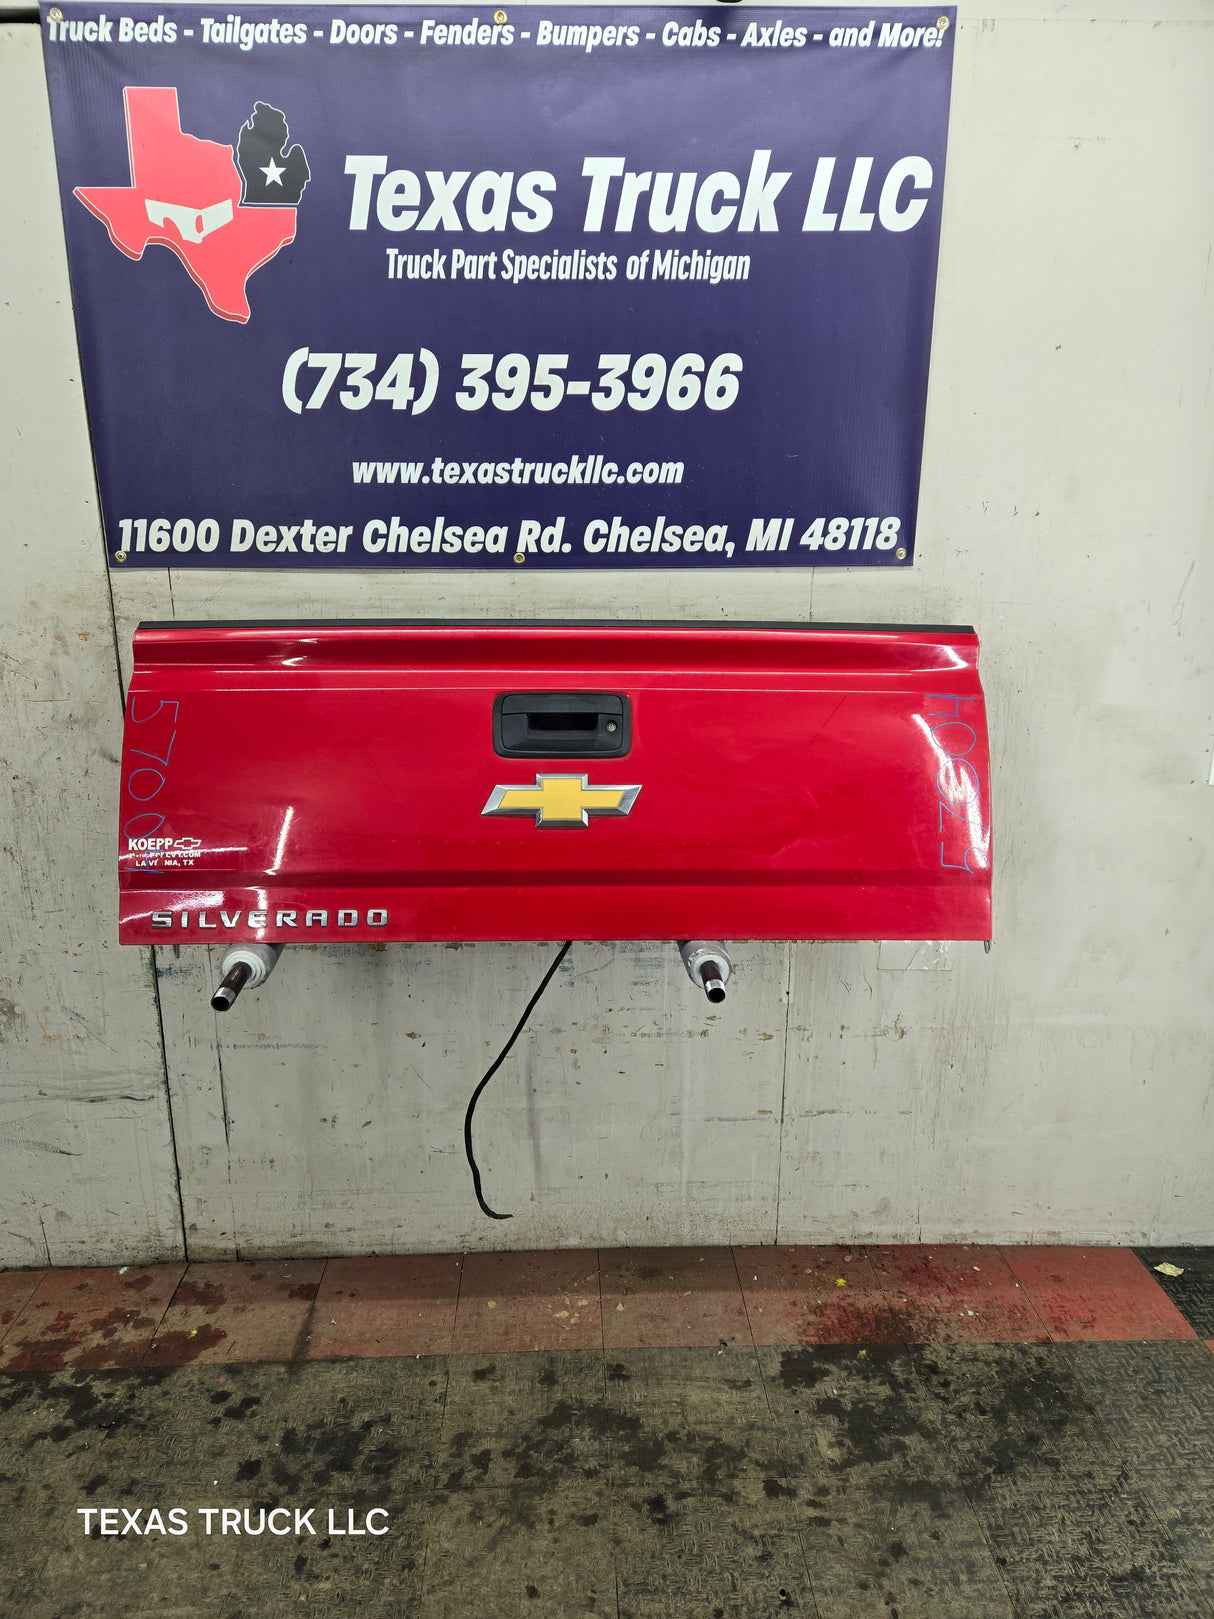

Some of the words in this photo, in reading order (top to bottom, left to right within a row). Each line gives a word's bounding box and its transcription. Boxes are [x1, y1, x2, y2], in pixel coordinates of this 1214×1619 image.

[46, 14, 114, 42] Truck
[118, 15, 178, 43] Beds
[183, 28, 194, 37] -
[200, 14, 308, 50] Tailgates
[313, 30, 324, 38] -
[329, 19, 399, 45] Doors
[403, 30, 415, 38] -
[419, 17, 516, 45] Fenders
[520, 31, 531, 39] -
[535, 20, 641, 53] Bumpers
[645, 32, 656, 40] -
[661, 20, 722, 47] Cabs
[726, 33, 736, 41] -
[740, 22, 808, 48] Axles
[812, 33, 824, 41] -
[828, 20, 876, 48] and
[877, 22, 946, 48] More!
[344, 155, 557, 233] Texas
[581, 149, 793, 233] Truck
[802, 156, 934, 233] LLC
[386, 248, 447, 280] Truck
[450, 248, 498, 280] Part
[500, 249, 618, 284] Specialists
[625, 249, 650, 281] of
[651, 249, 752, 285] Michigan
[281, 346, 440, 416] (734)
[455, 352, 744, 412] 395-3966
[352, 454, 685, 485] www.texastruckllc.com
[118, 518, 220, 552] 11600
[231, 519, 354, 553] Dexter
[362, 517, 509, 554] Chelsea
[516, 516, 572, 553] Rd.
[583, 516, 736, 558] Chelsea,
[745, 518, 795, 552] MI
[799, 516, 902, 551] 48118
[128, 838, 173, 850] KOEPP
[182, 859, 195, 867] TX
[151, 908, 389, 928] SILVERADO
